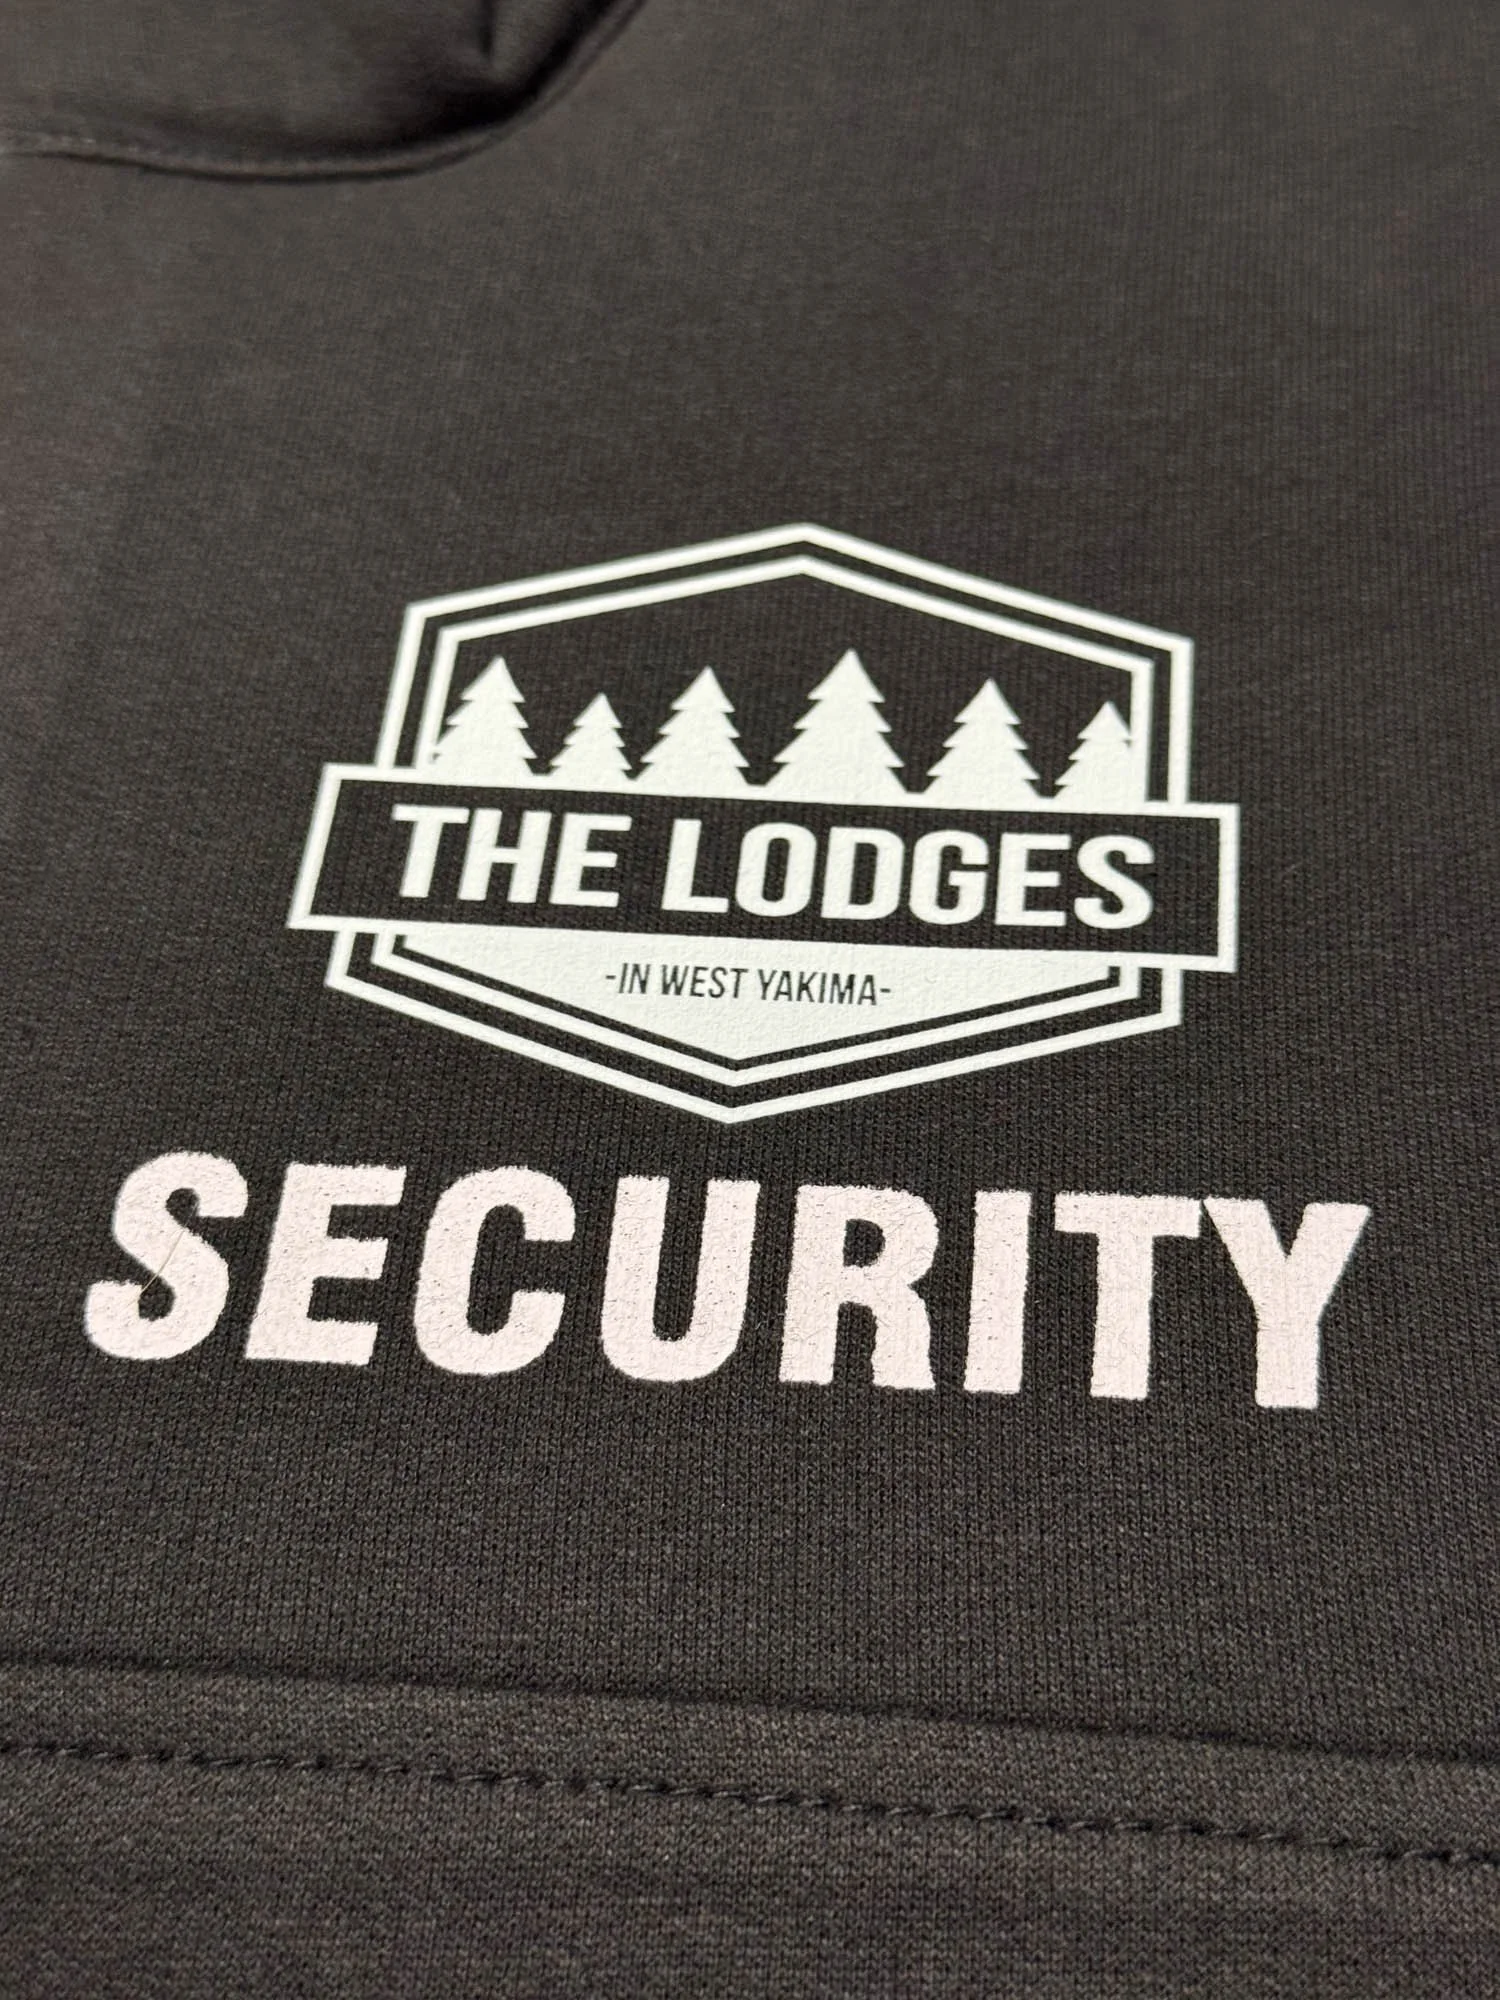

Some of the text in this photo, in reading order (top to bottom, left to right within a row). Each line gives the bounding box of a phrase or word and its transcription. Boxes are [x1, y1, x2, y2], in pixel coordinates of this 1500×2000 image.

[391, 803, 1154, 930] THE LODGES
[660, 964, 749, 999] WEST
[83, 1150, 1371, 1411] SECURITY
